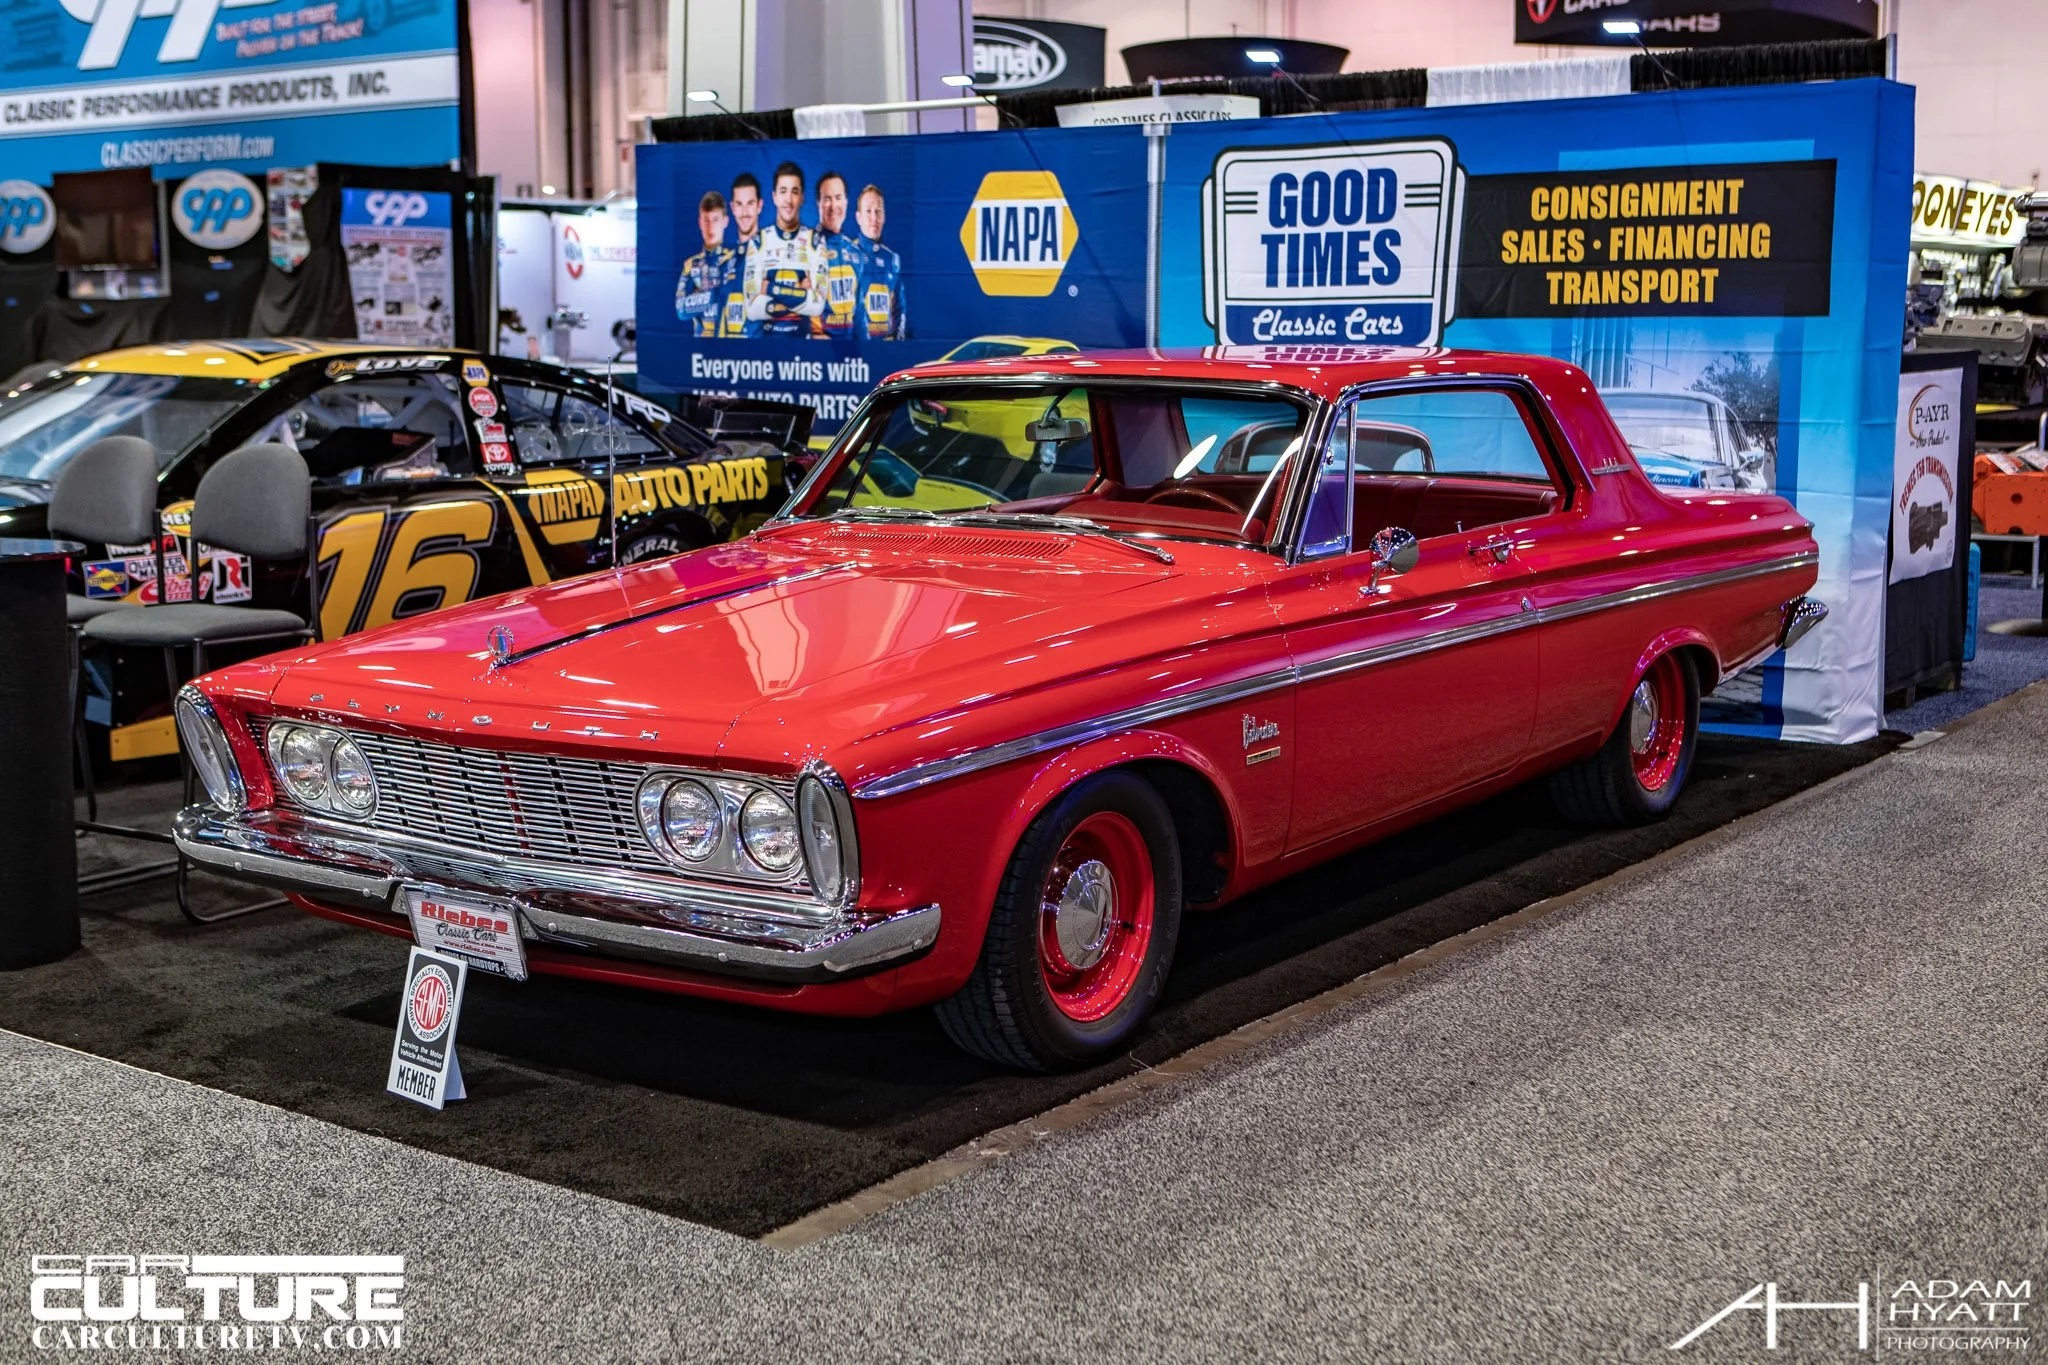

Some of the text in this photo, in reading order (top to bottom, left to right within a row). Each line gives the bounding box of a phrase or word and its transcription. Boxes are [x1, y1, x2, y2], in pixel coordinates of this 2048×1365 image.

[4, 71, 390, 124] CLASSIC PERFORMANCE PRODUCTS, INC.
[1268, 167, 1399, 228] GOOD
[1530, 178, 1744, 222] CONSIGNMENT
[1913, 181, 2016, 236] OONEYES
[981, 206, 1058, 262] NAPA
[1501, 221, 1771, 265] SALES FINANCING
[1261, 228, 1402, 289] TIMES
[1546, 267, 1719, 306] TRANSPORT
[1252, 307, 1404, 342] Classic Cars
[356, 357, 440, 372] LOVE
[691, 353, 870, 384] Everyone wins with
[600, 384, 672, 423] TRD
[1915, 404, 1949, 425] P-AYR
[539, 480, 597, 523] NAPA
[613, 456, 768, 518] AUTO PARTS
[129, 557, 183, 573] QUATER
[318, 498, 496, 642] 16
[619, 537, 680, 566] NERAL
[140, 565, 186, 578] MATER
[421, 901, 508, 933] Riebes
[436, 922, 498, 942] Classic Cars
[411, 967, 452, 1007] SPECIALTY EQUIPMENT
[416, 978, 445, 1028] SEMA
[408, 1000, 450, 1039] MARKET ASSOCIATION
[400, 1048, 417, 1060] Vehicle
[401, 1040, 444, 1060] Serving the Motor
[396, 1064, 437, 1101] MEMBER
